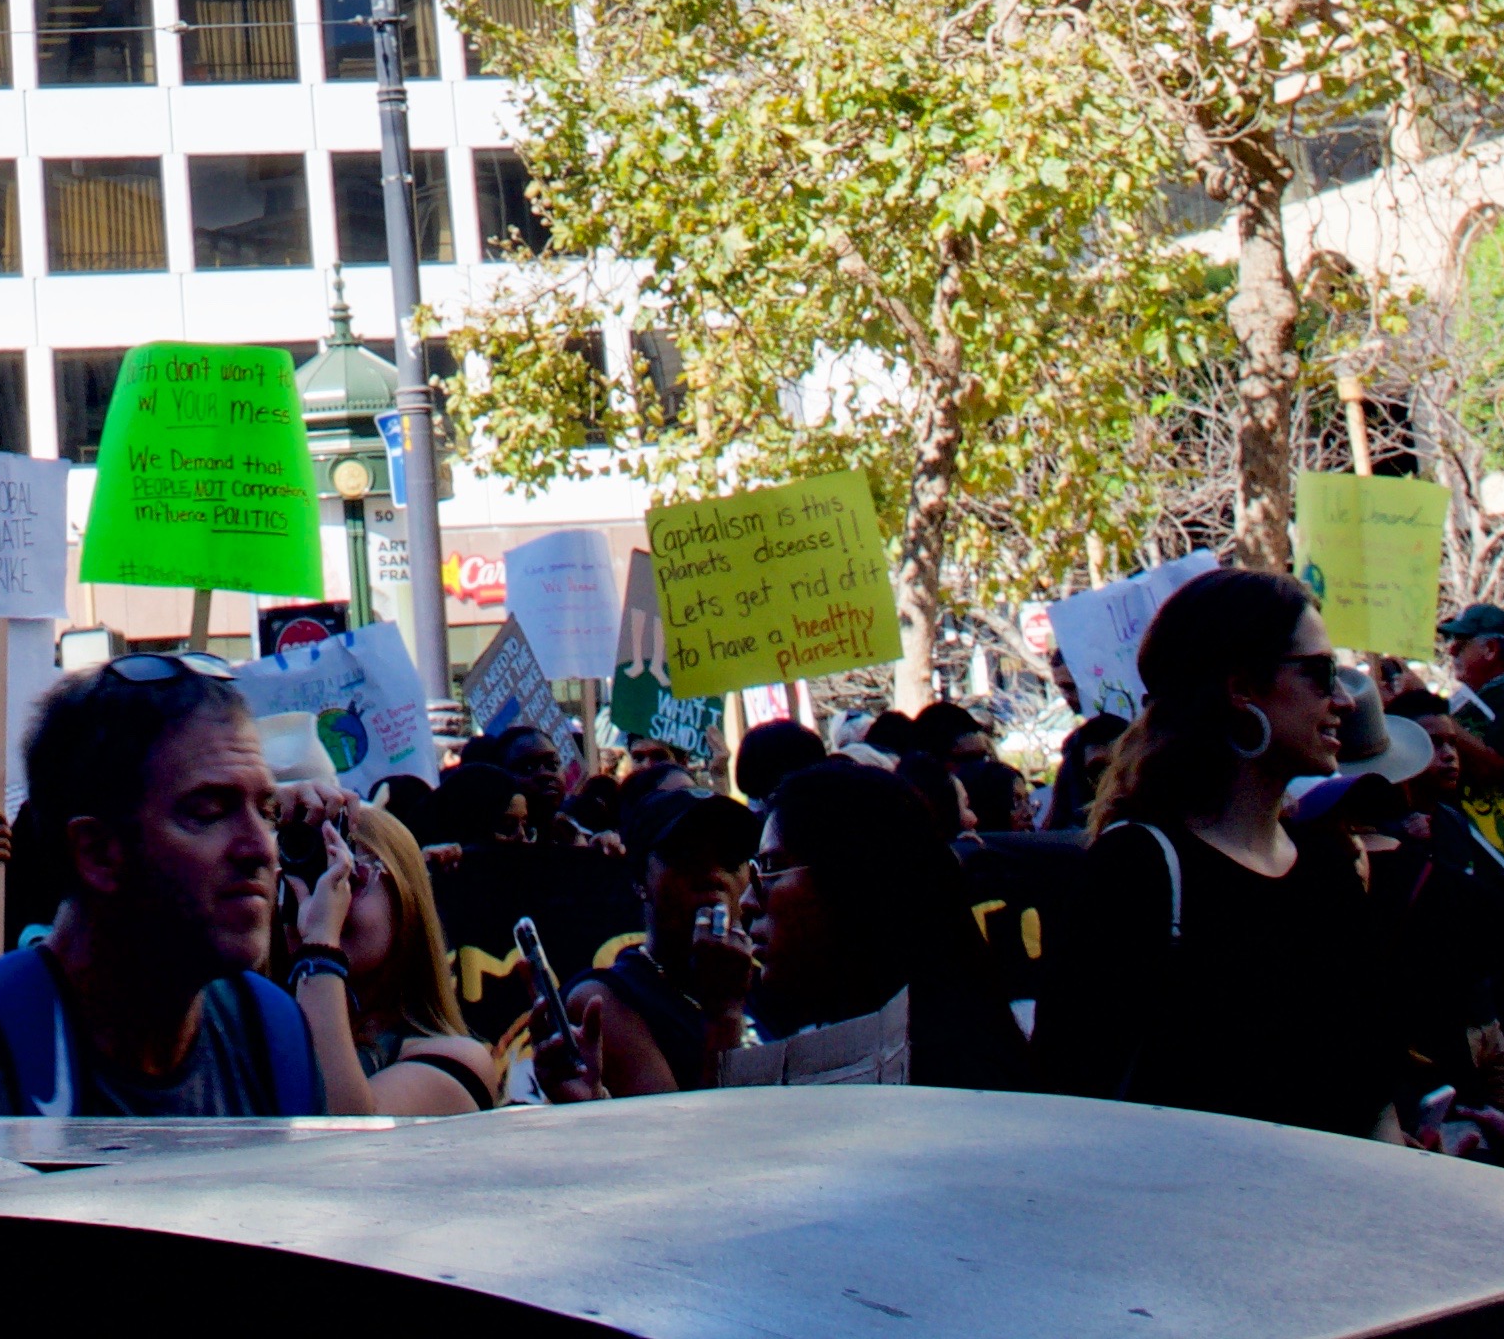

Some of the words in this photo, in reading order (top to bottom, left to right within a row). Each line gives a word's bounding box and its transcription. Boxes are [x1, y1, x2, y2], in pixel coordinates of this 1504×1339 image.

[172, 389, 218, 423] YOUR
[128, 444, 164, 473] We
[170, 447, 235, 473] Demand
[243, 455, 286, 477] that
[132, 476, 191, 497] PEOPLE
[194, 480, 227, 499] NOT
[213, 504, 289, 531] POLITICS
[374, 510, 394, 522] 50
[650, 508, 765, 560] Capitalism
[777, 505, 795, 525] is
[801, 494, 844, 520] this
[378, 555, 409, 567] SAN
[666, 590, 724, 628] Lets
[735, 577, 773, 618] get
[790, 567, 829, 603] rid
[862, 558, 881, 584] it
[673, 637, 699, 671] to
[707, 627, 758, 660] have
[768, 629, 784, 644] a
[792, 601, 874, 640] healthy
[776, 629, 874, 678] planet!!
[657, 689, 707, 727] WHAT
[649, 714, 699, 754] STAND
